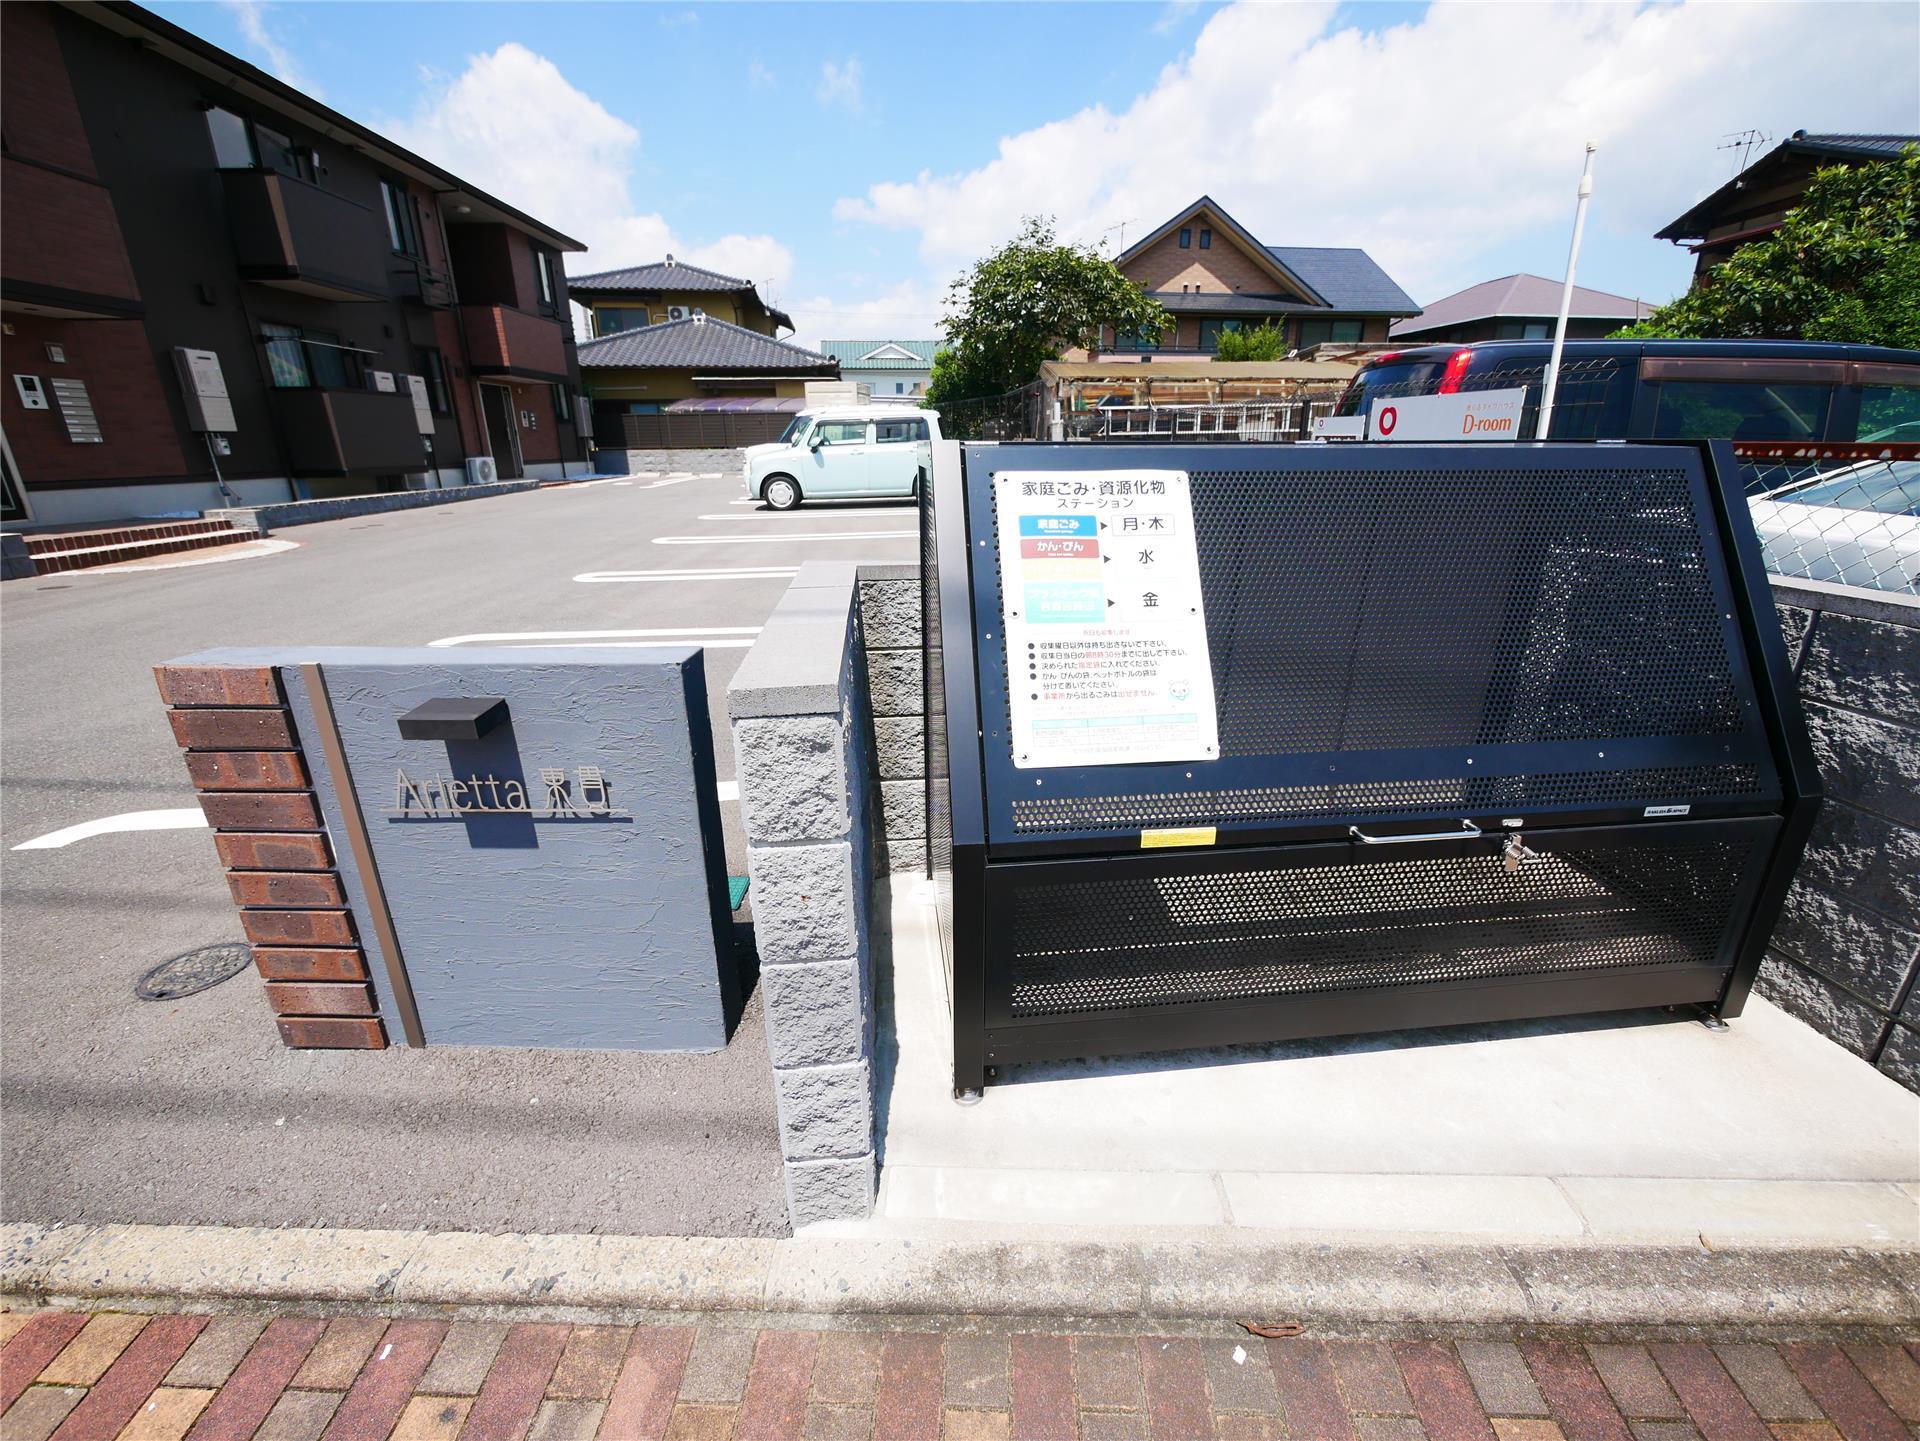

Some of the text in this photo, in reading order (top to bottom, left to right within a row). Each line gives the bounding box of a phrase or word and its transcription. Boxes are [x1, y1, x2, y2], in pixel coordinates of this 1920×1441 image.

[1462, 414, 1512, 434] D-room
[1022, 480, 1166, 496] 家庭ごみ・資源化物
[1057, 497, 1134, 509] ステーション
[1123, 516, 1165, 531] 月・木
[1037, 541, 1085, 552] かん・びん
[1138, 549, 1155, 564] 水
[1142, 591, 1159, 608] 金
[1041, 649, 1188, 660] 収集日当日の30分までに出して下さい。
[396, 767, 532, 811] Arietta
